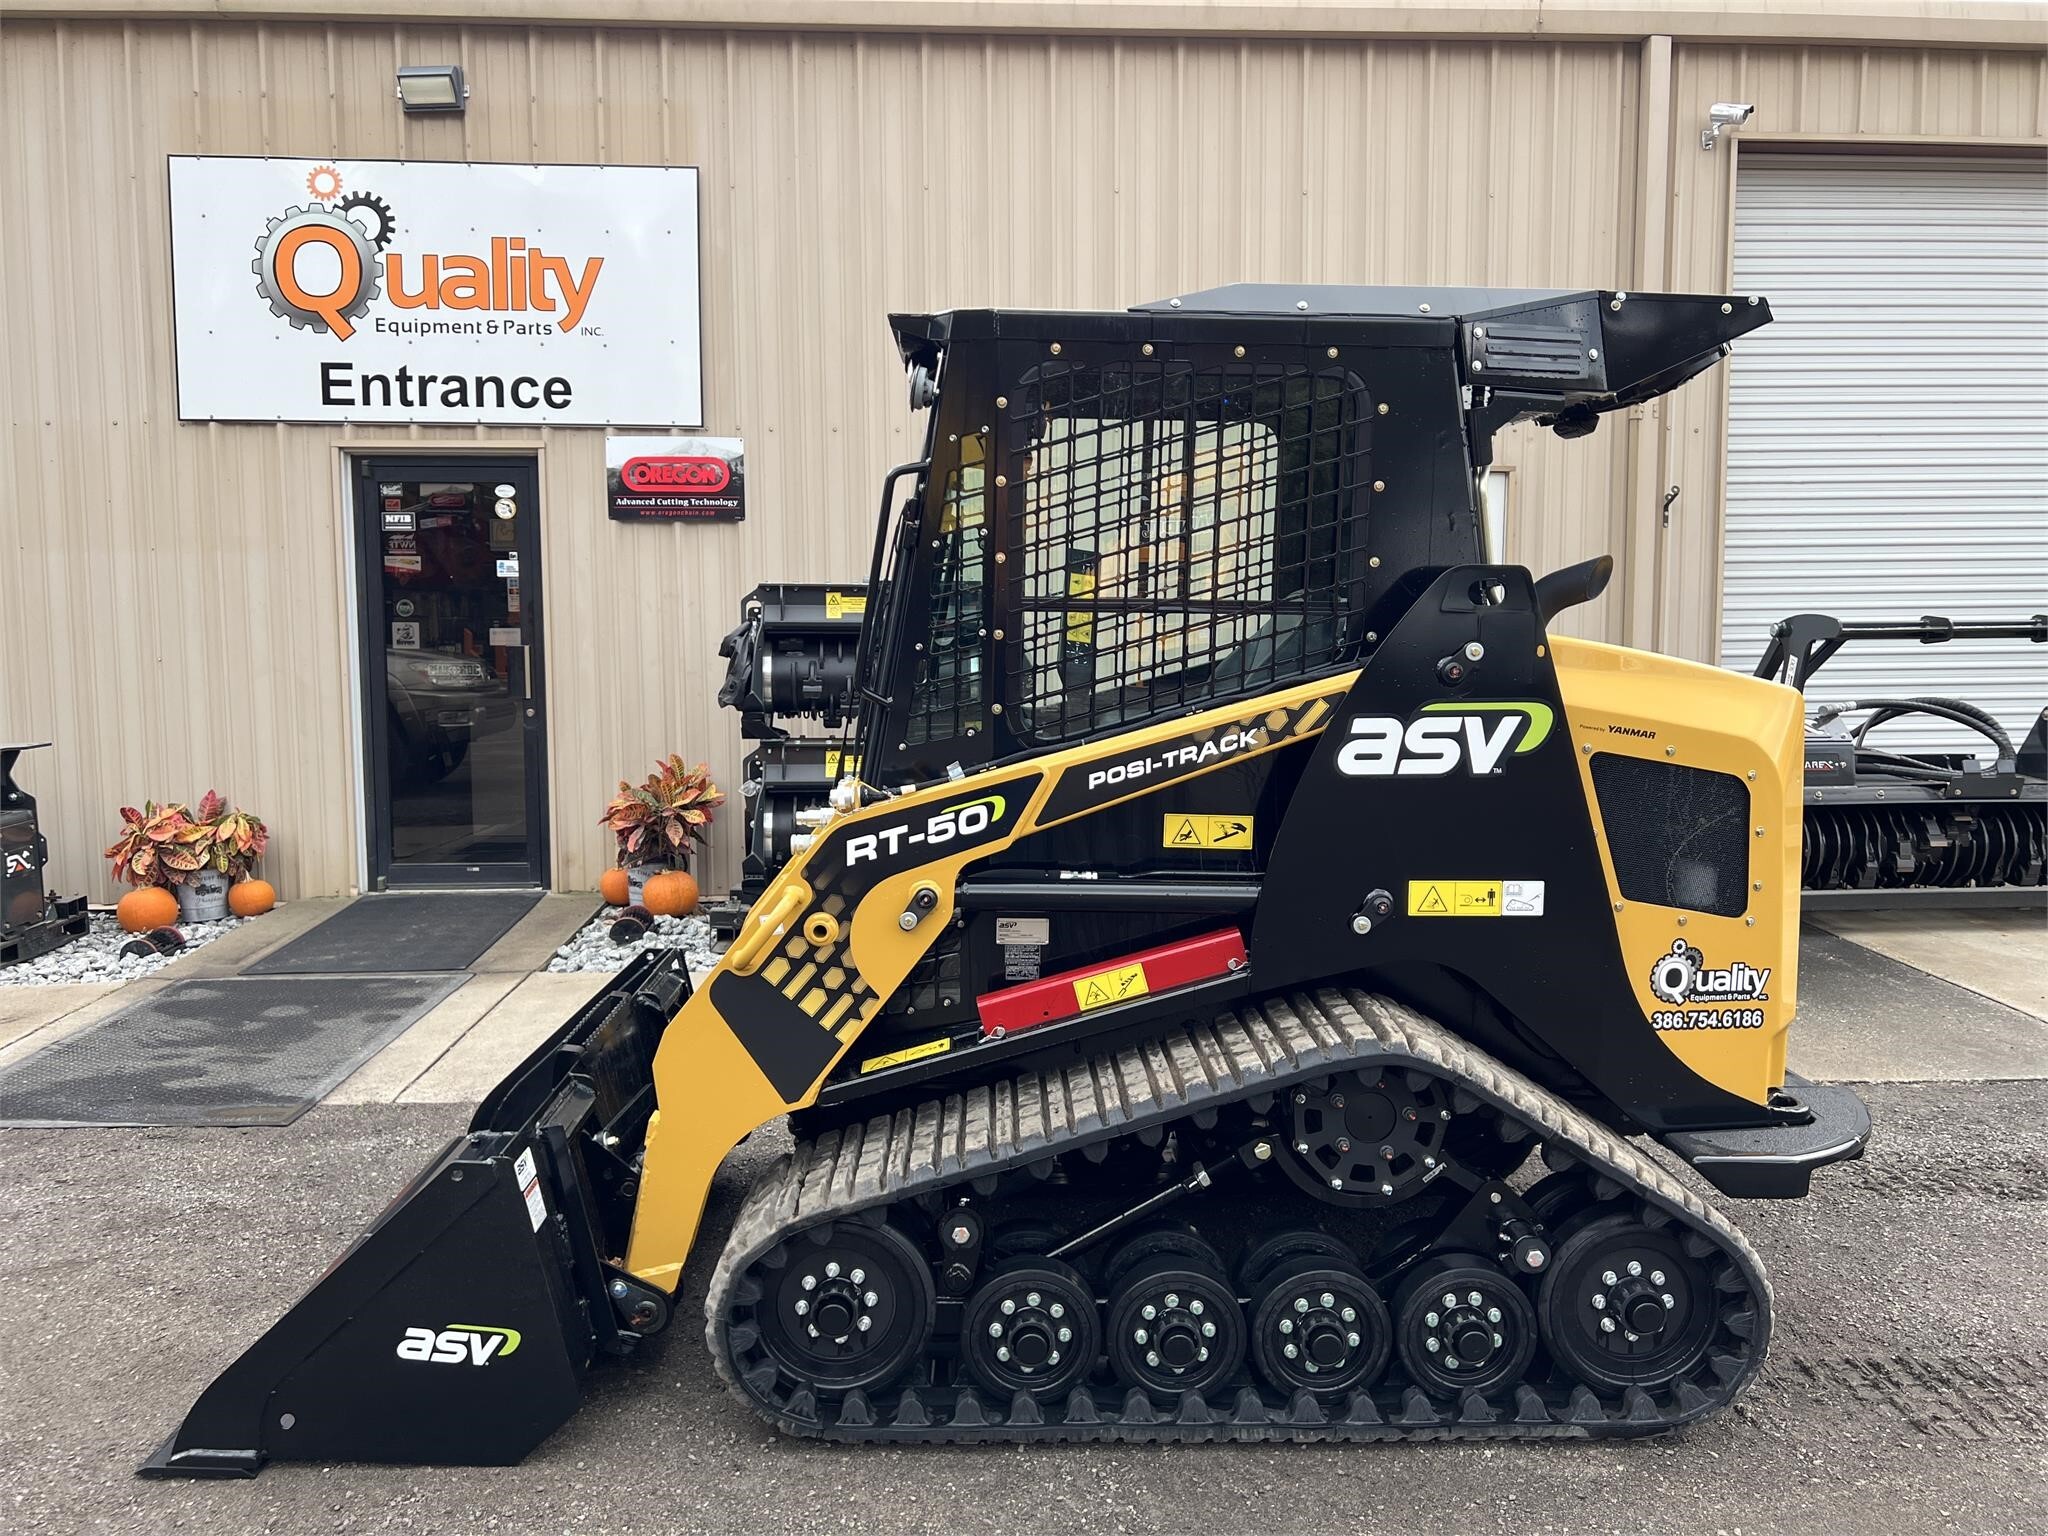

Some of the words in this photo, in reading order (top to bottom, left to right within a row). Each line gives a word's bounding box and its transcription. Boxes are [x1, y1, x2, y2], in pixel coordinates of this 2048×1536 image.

[273, 224, 605, 342] Quality
[375, 317, 483, 337] Equipment
[486, 319, 500, 335] &
[503, 319, 553, 336] Parts
[580, 326, 605, 337] INC.
[319, 361, 573, 409] Entrance
[634, 464, 717, 484] OREGON
[615, 498, 656, 506] Advanced
[656, 498, 689, 507] Cutting
[689, 498, 738, 507] Technology
[385, 514, 412, 523] NFIB
[1607, 724, 1657, 740] YANMAR
[1087, 727, 1259, 791] POSI-TRACK
[845, 803, 990, 867] RT-50
[1659, 961, 1771, 1005] Quality
[1690, 993, 1728, 1002] Equipment
[1652, 1010, 1763, 1029] 386.754.6186
